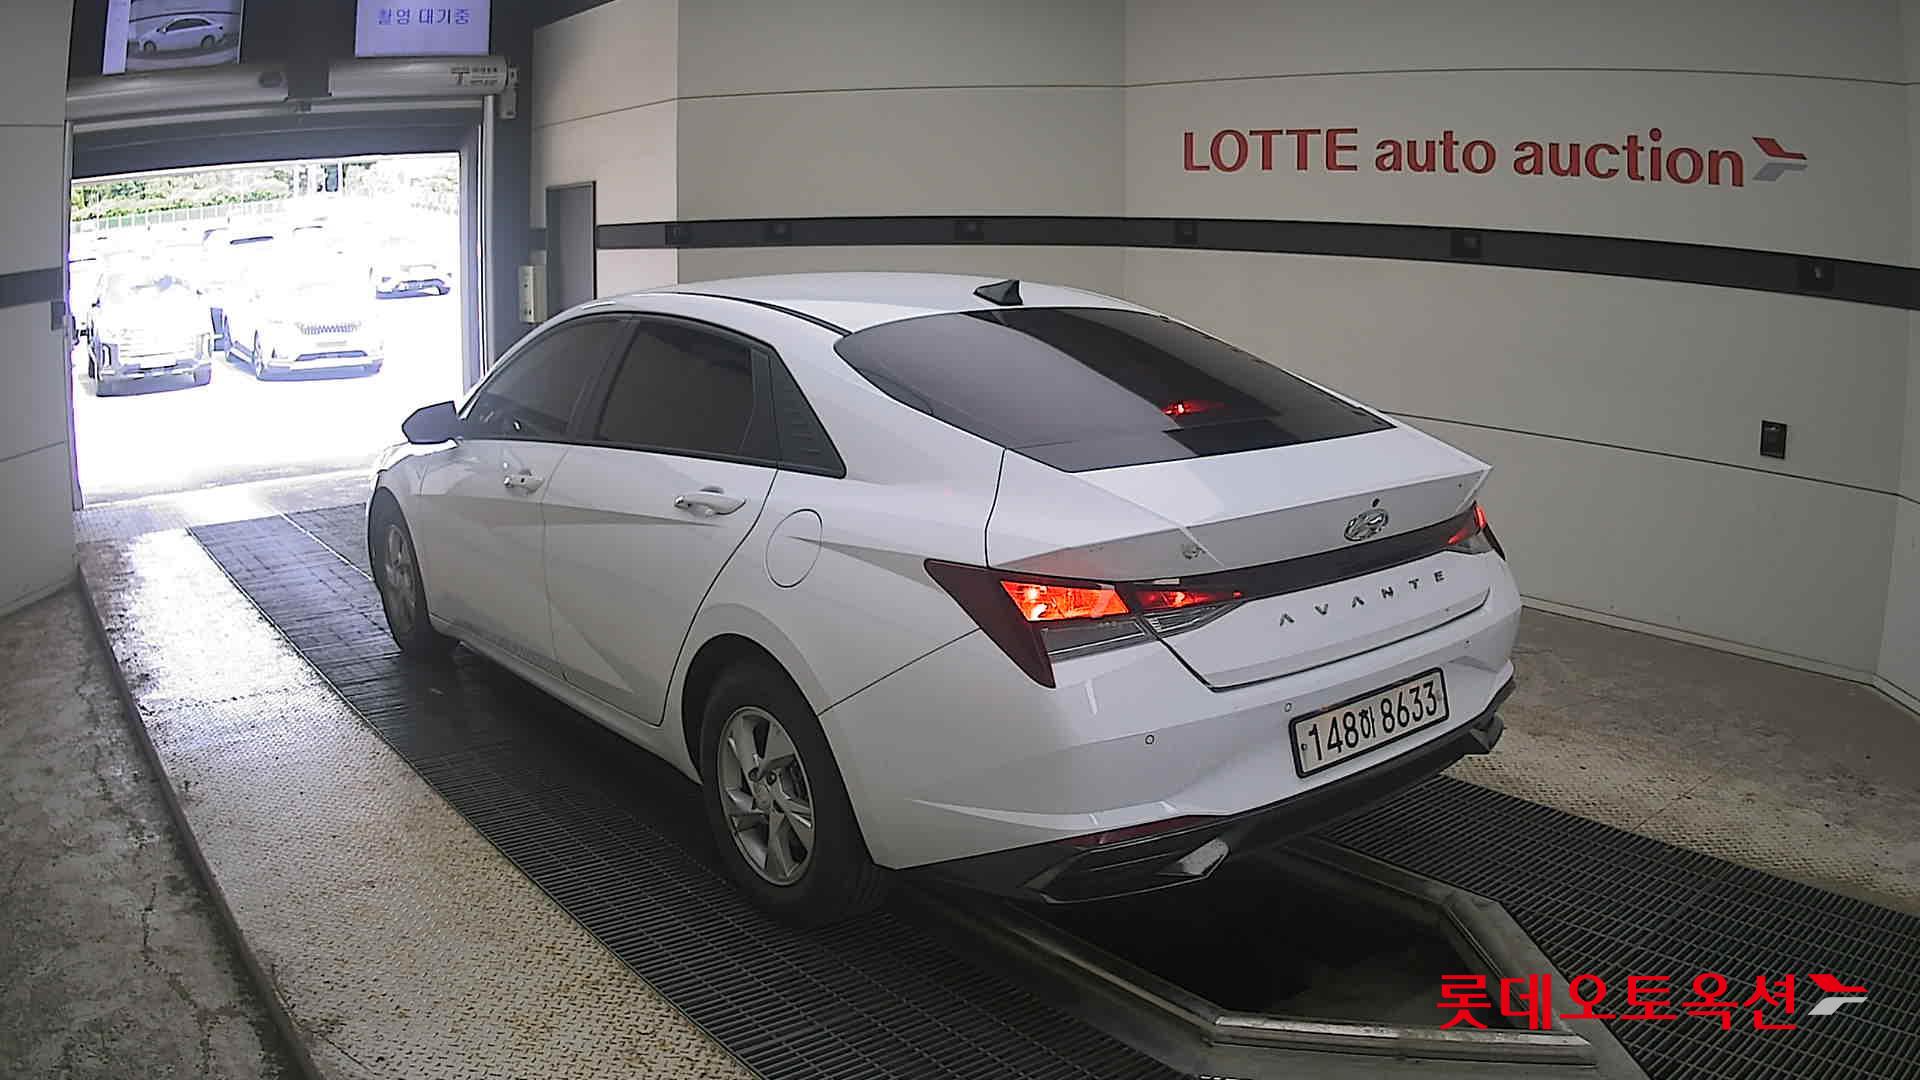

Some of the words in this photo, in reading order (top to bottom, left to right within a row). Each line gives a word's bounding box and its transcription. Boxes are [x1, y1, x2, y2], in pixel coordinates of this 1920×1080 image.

[418, 9, 471, 25] 대기중
[1184, 129, 1359, 172] LOTTE
[1374, 131, 1496, 173] auto
[1513, 128, 1744, 187] auction
[1279, 570, 1445, 627] AVANTE
[1382, 682, 1437, 733] 8633
